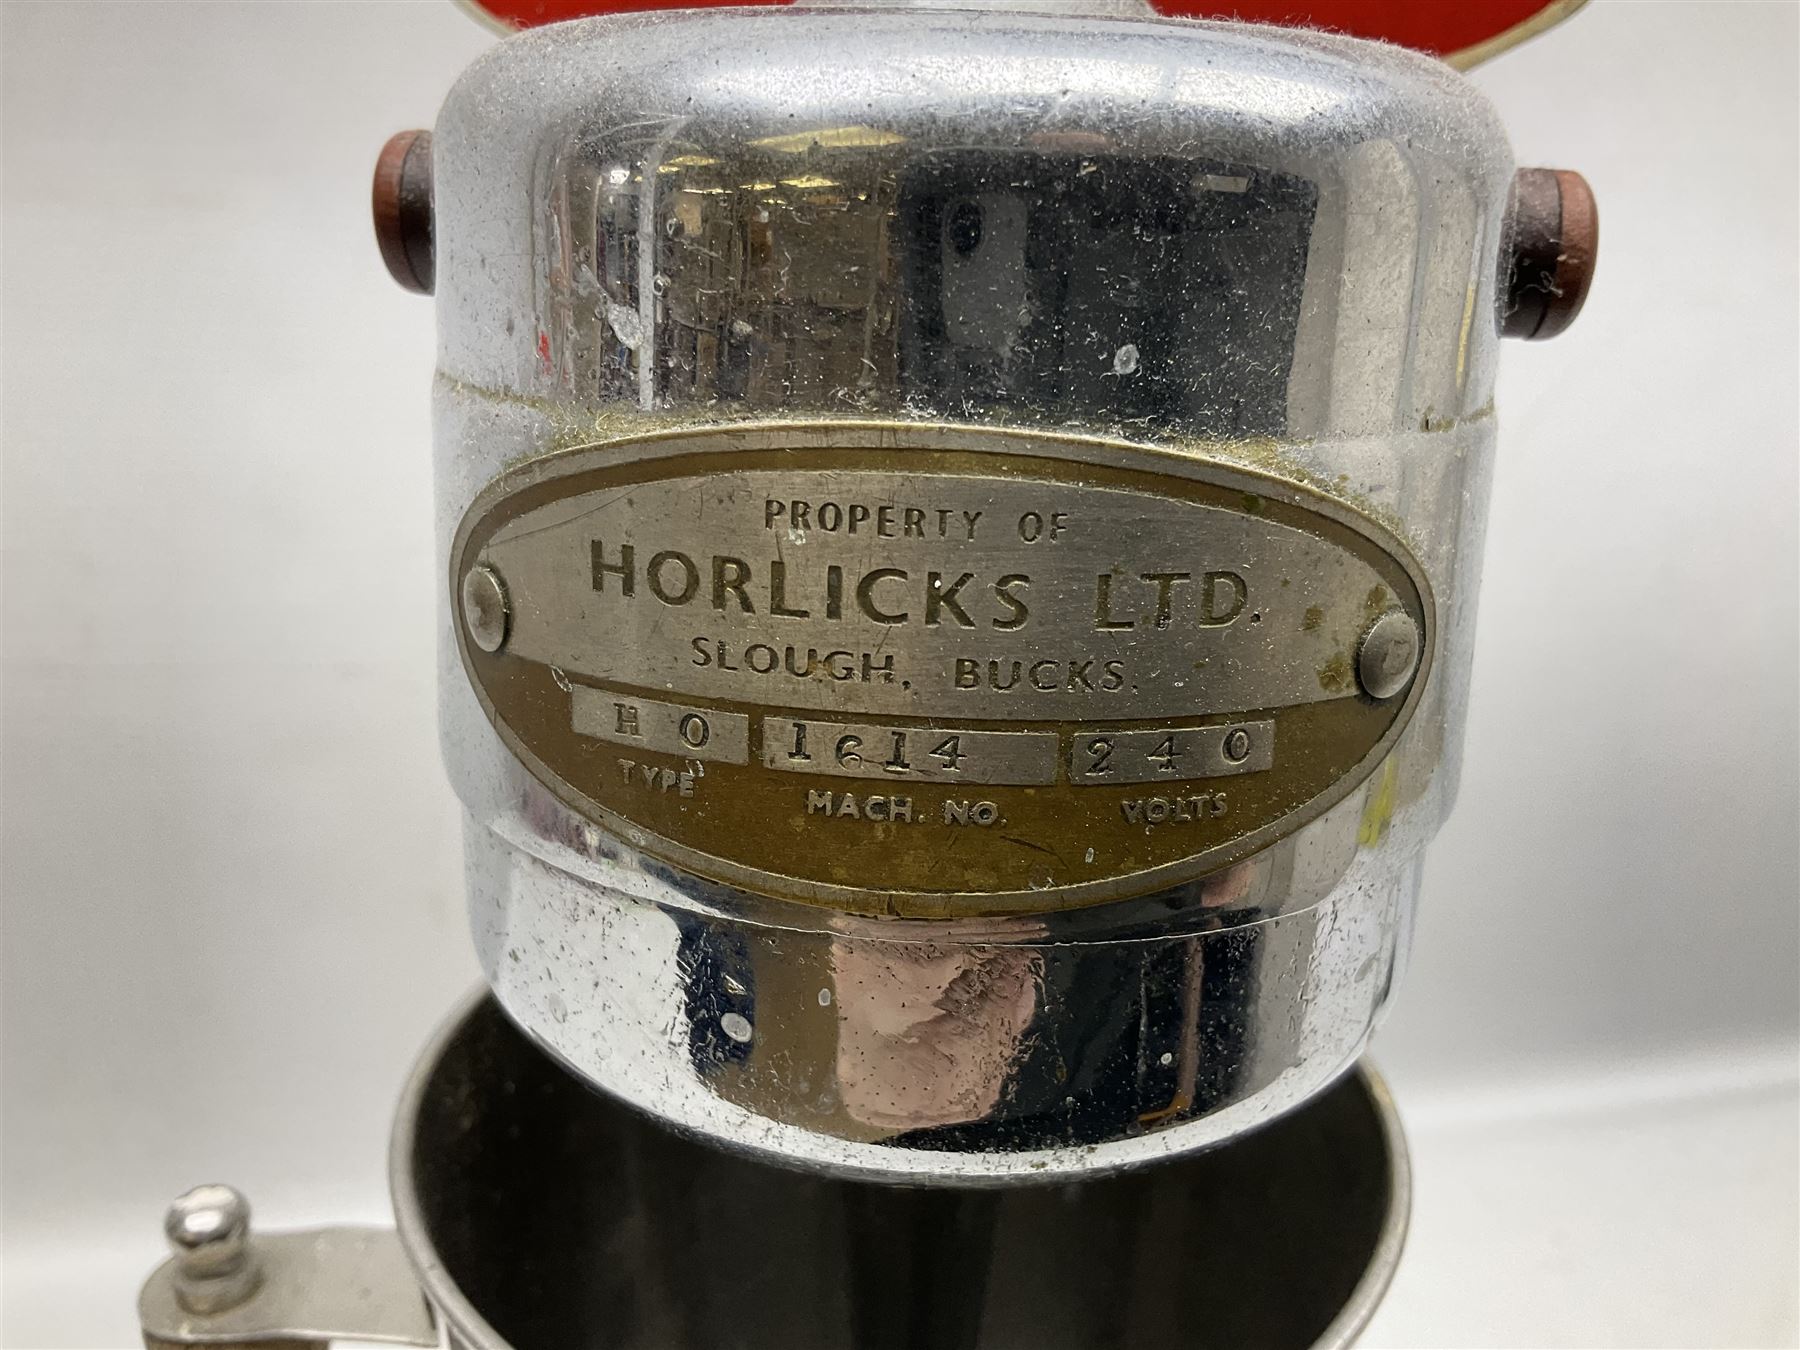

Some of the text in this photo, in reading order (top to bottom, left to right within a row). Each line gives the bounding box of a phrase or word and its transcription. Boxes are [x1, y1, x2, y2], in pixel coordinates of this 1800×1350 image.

[764, 498, 1069, 544] PROPERTY OF
[590, 539, 1262, 633] HORLICKS LTD.
[954, 658, 1139, 693] BUCKS.
[616, 759, 695, 798] TYPE
[807, 789, 1008, 828] MACH. NO.
[1120, 792, 1229, 825] VOLTS
